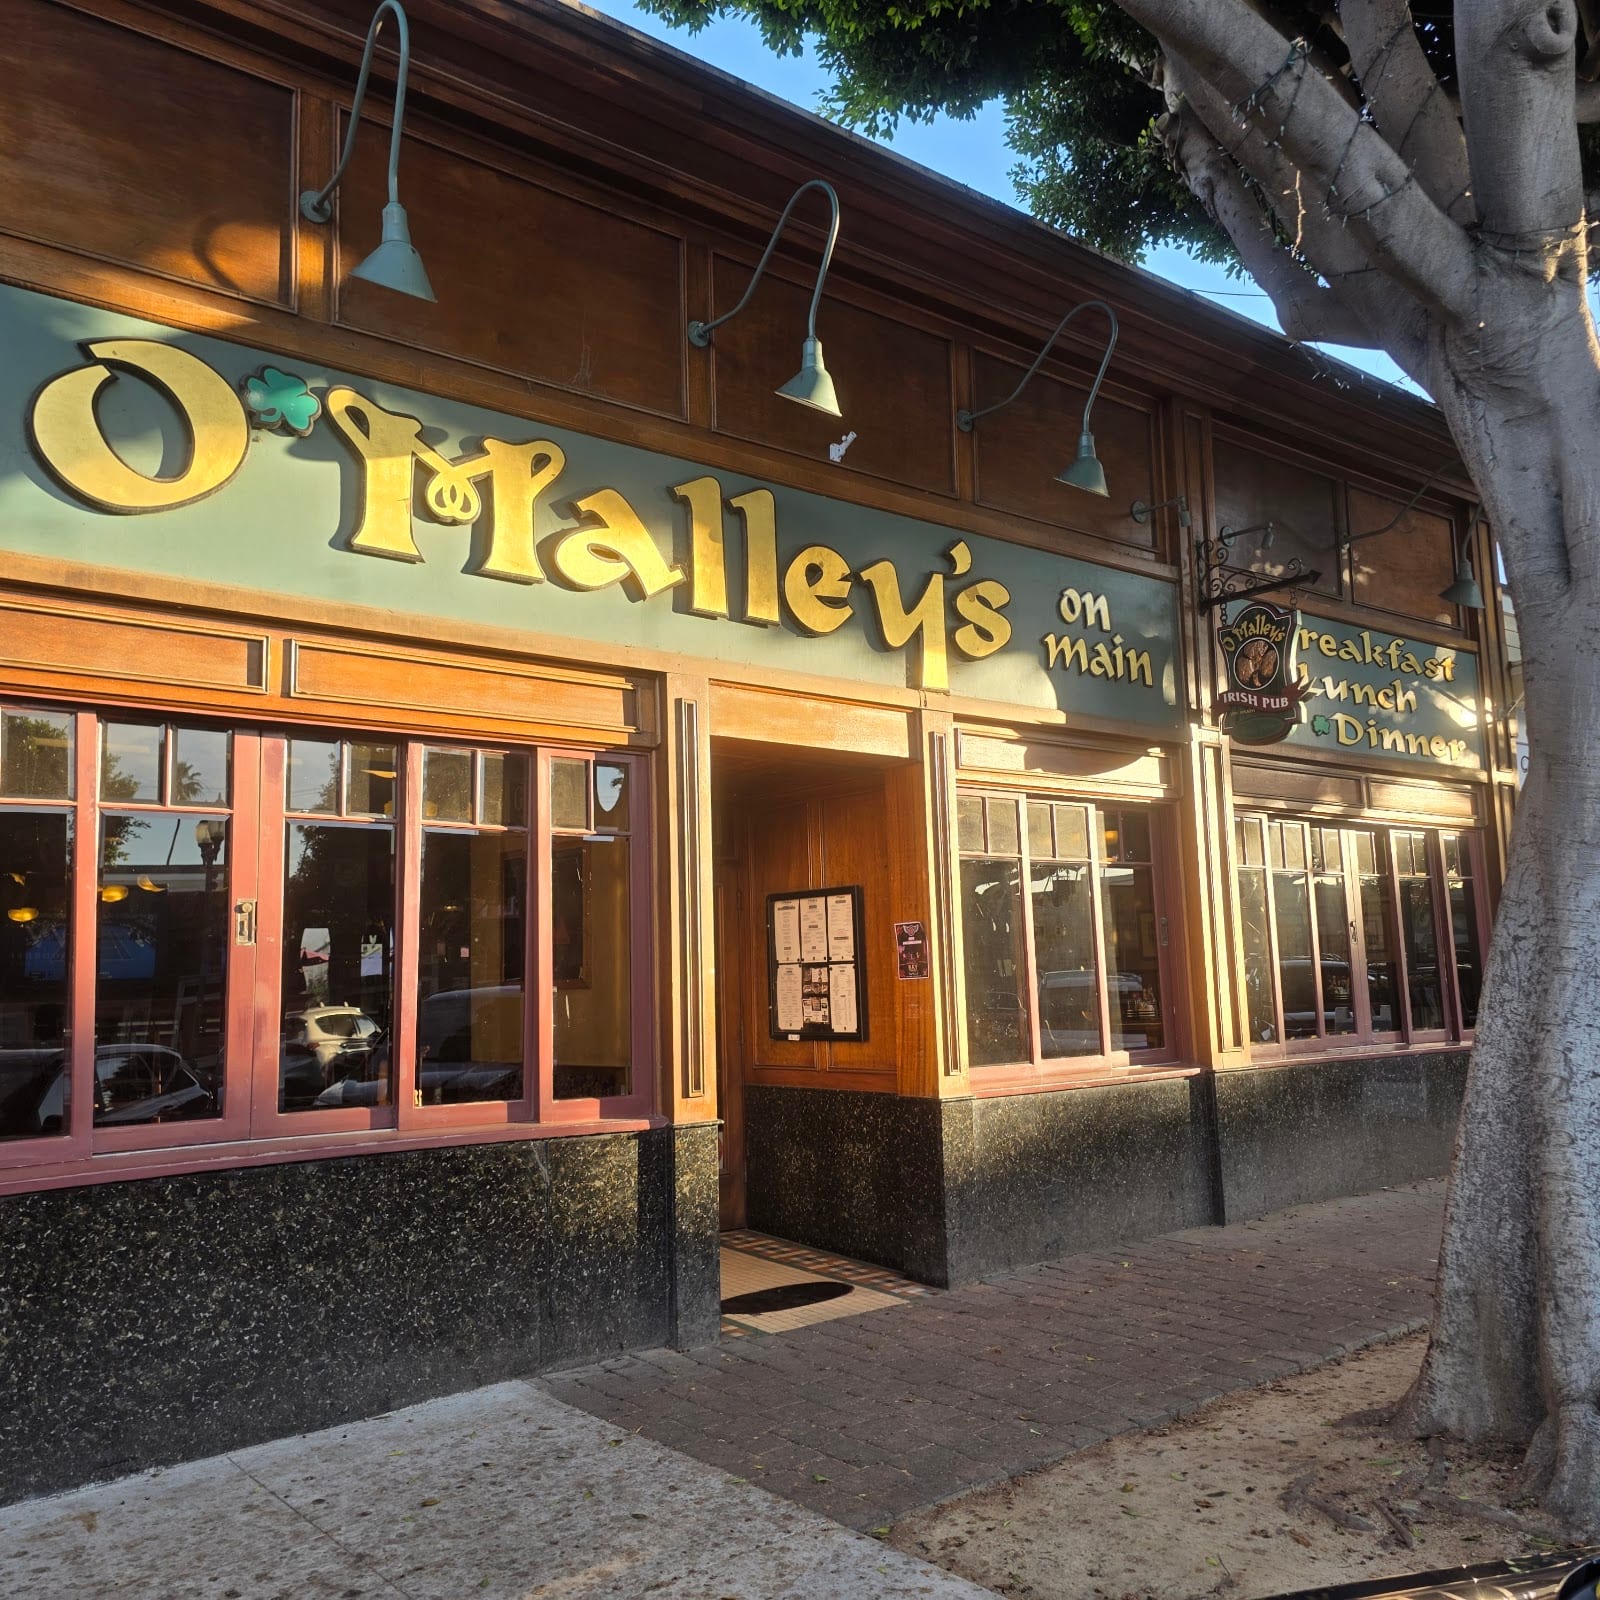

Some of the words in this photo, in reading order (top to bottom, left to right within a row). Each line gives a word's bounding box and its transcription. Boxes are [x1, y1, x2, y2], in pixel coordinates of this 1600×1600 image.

[1059, 587, 1112, 632] on
[1298, 630, 1457, 682] reakfast
[1223, 692, 1258, 707] IRISH
[1262, 697, 1289, 709] PUB
[1327, 712, 1467, 761] Dinner
